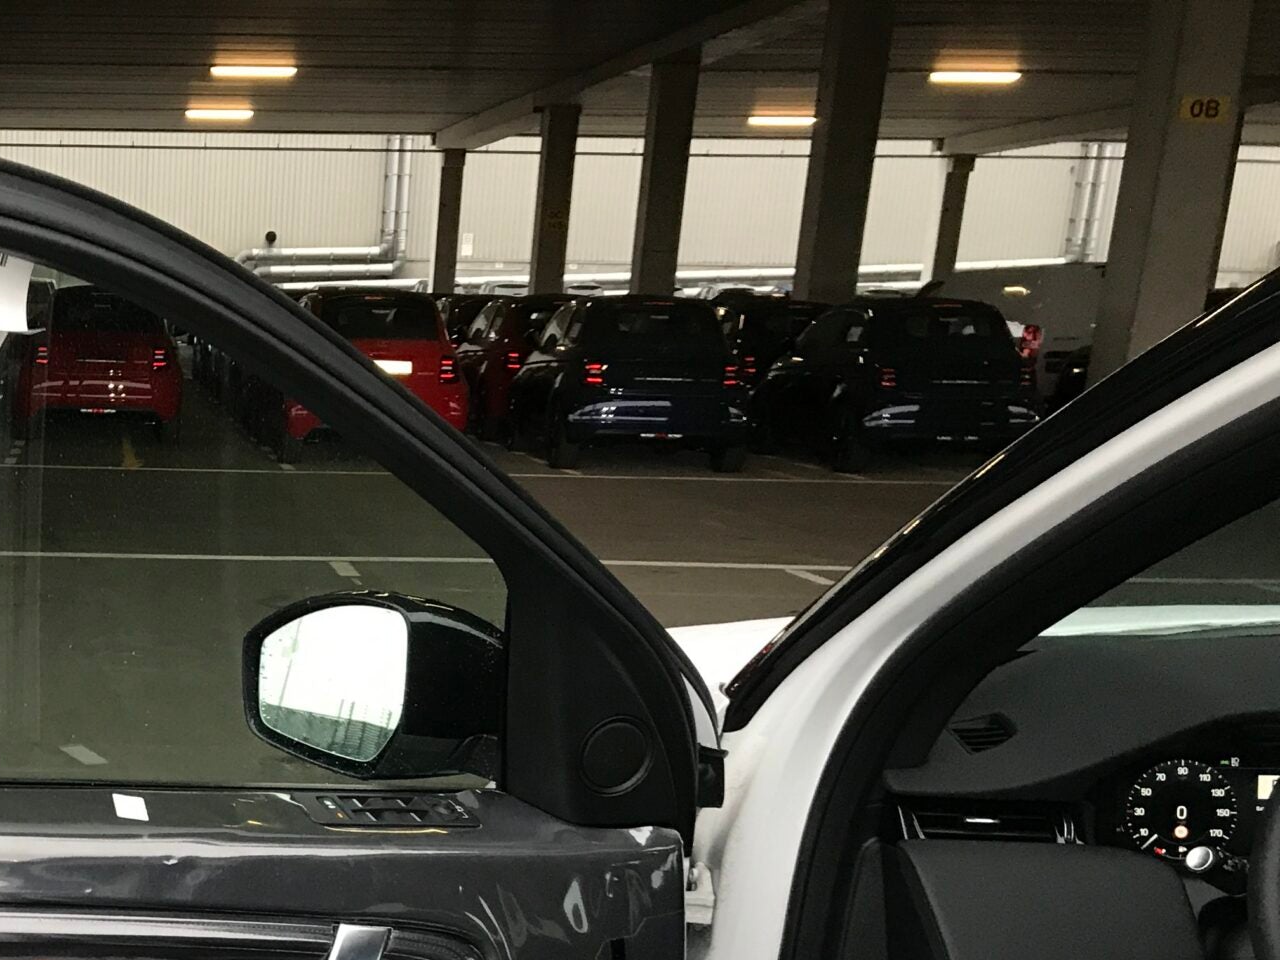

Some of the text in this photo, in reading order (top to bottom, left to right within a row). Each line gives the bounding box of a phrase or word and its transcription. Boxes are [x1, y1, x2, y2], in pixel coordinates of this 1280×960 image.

[1177, 767, 1188, 775] 90
[1155, 773, 1166, 781] 70
[1199, 773, 1211, 782] 110
[1140, 788, 1152, 796] 50
[1211, 789, 1225, 797] 130
[1133, 807, 1145, 816] 30
[1176, 805, 1187, 820] 0
[1216, 808, 1230, 817] 150
[1140, 828, 1149, 836] 10
[1209, 829, 1223, 837] 170
